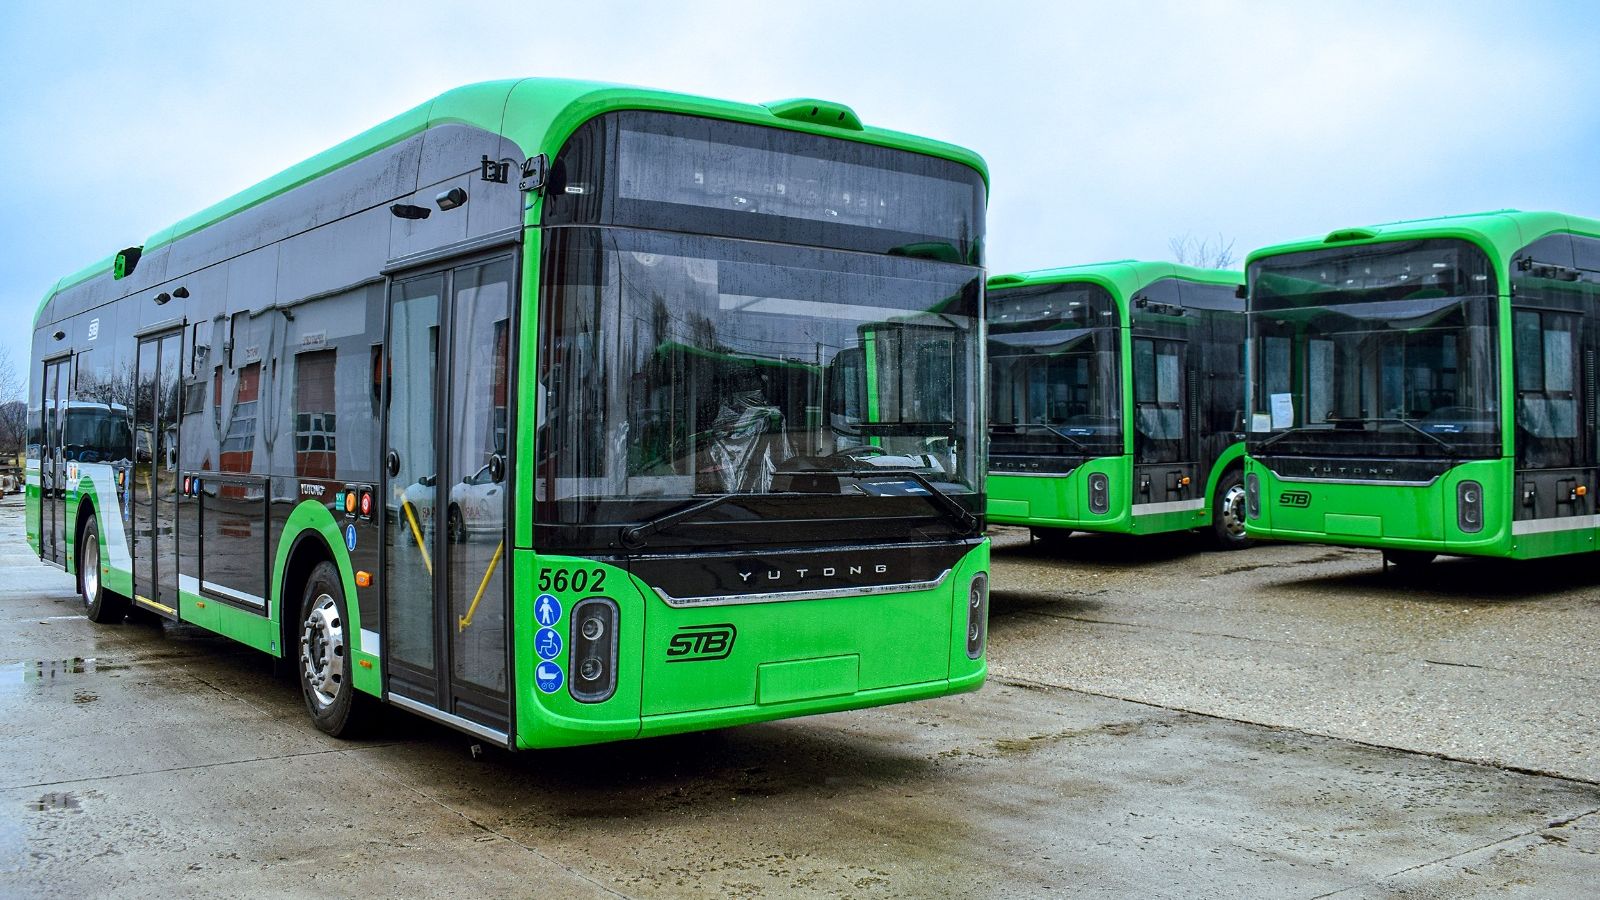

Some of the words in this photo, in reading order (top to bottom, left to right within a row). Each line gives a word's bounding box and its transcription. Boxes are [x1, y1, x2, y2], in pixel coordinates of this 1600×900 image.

[1309, 466, 1393, 474] YUTONG
[1280, 492, 1309, 506] STB
[538, 567, 607, 593] 5602
[739, 564, 887, 582] YUTONG
[666, 628, 731, 658] STB
